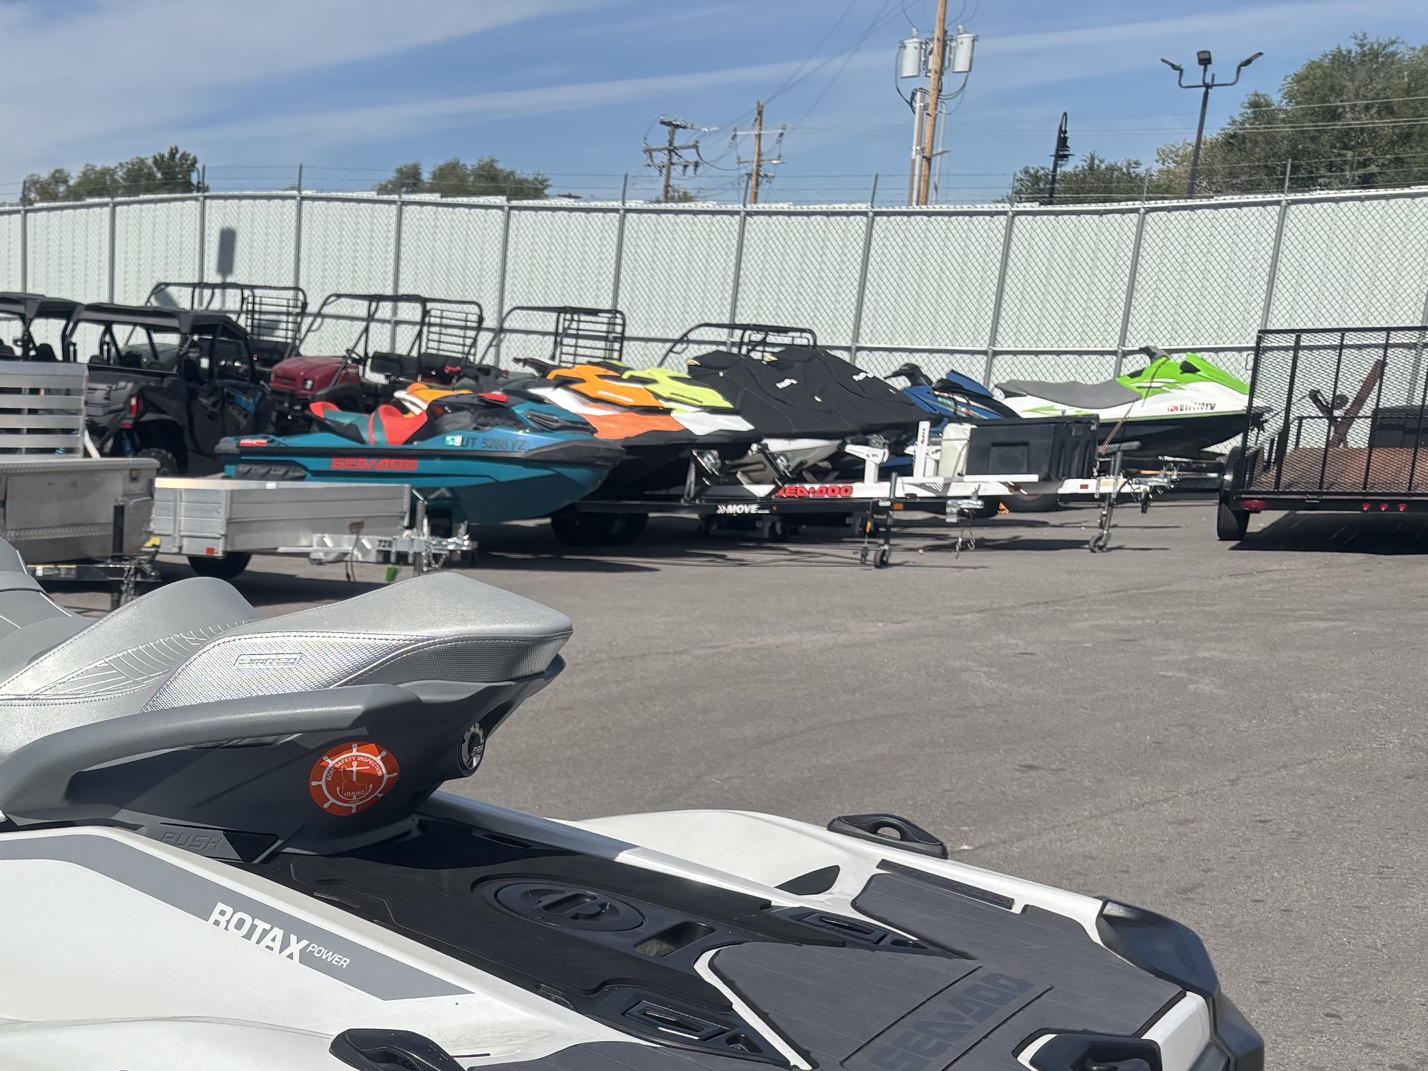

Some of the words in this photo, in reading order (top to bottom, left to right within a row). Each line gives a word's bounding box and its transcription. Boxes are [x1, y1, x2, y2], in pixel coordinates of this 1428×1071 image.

[725, 504, 759, 515] MOVE
[334, 756, 357, 769] SAFETY
[357, 756, 383, 777] INSPECTION
[162, 831, 224, 852] PUSH
[206, 901, 310, 964] ROTAX
[306, 942, 352, 969] POWER
